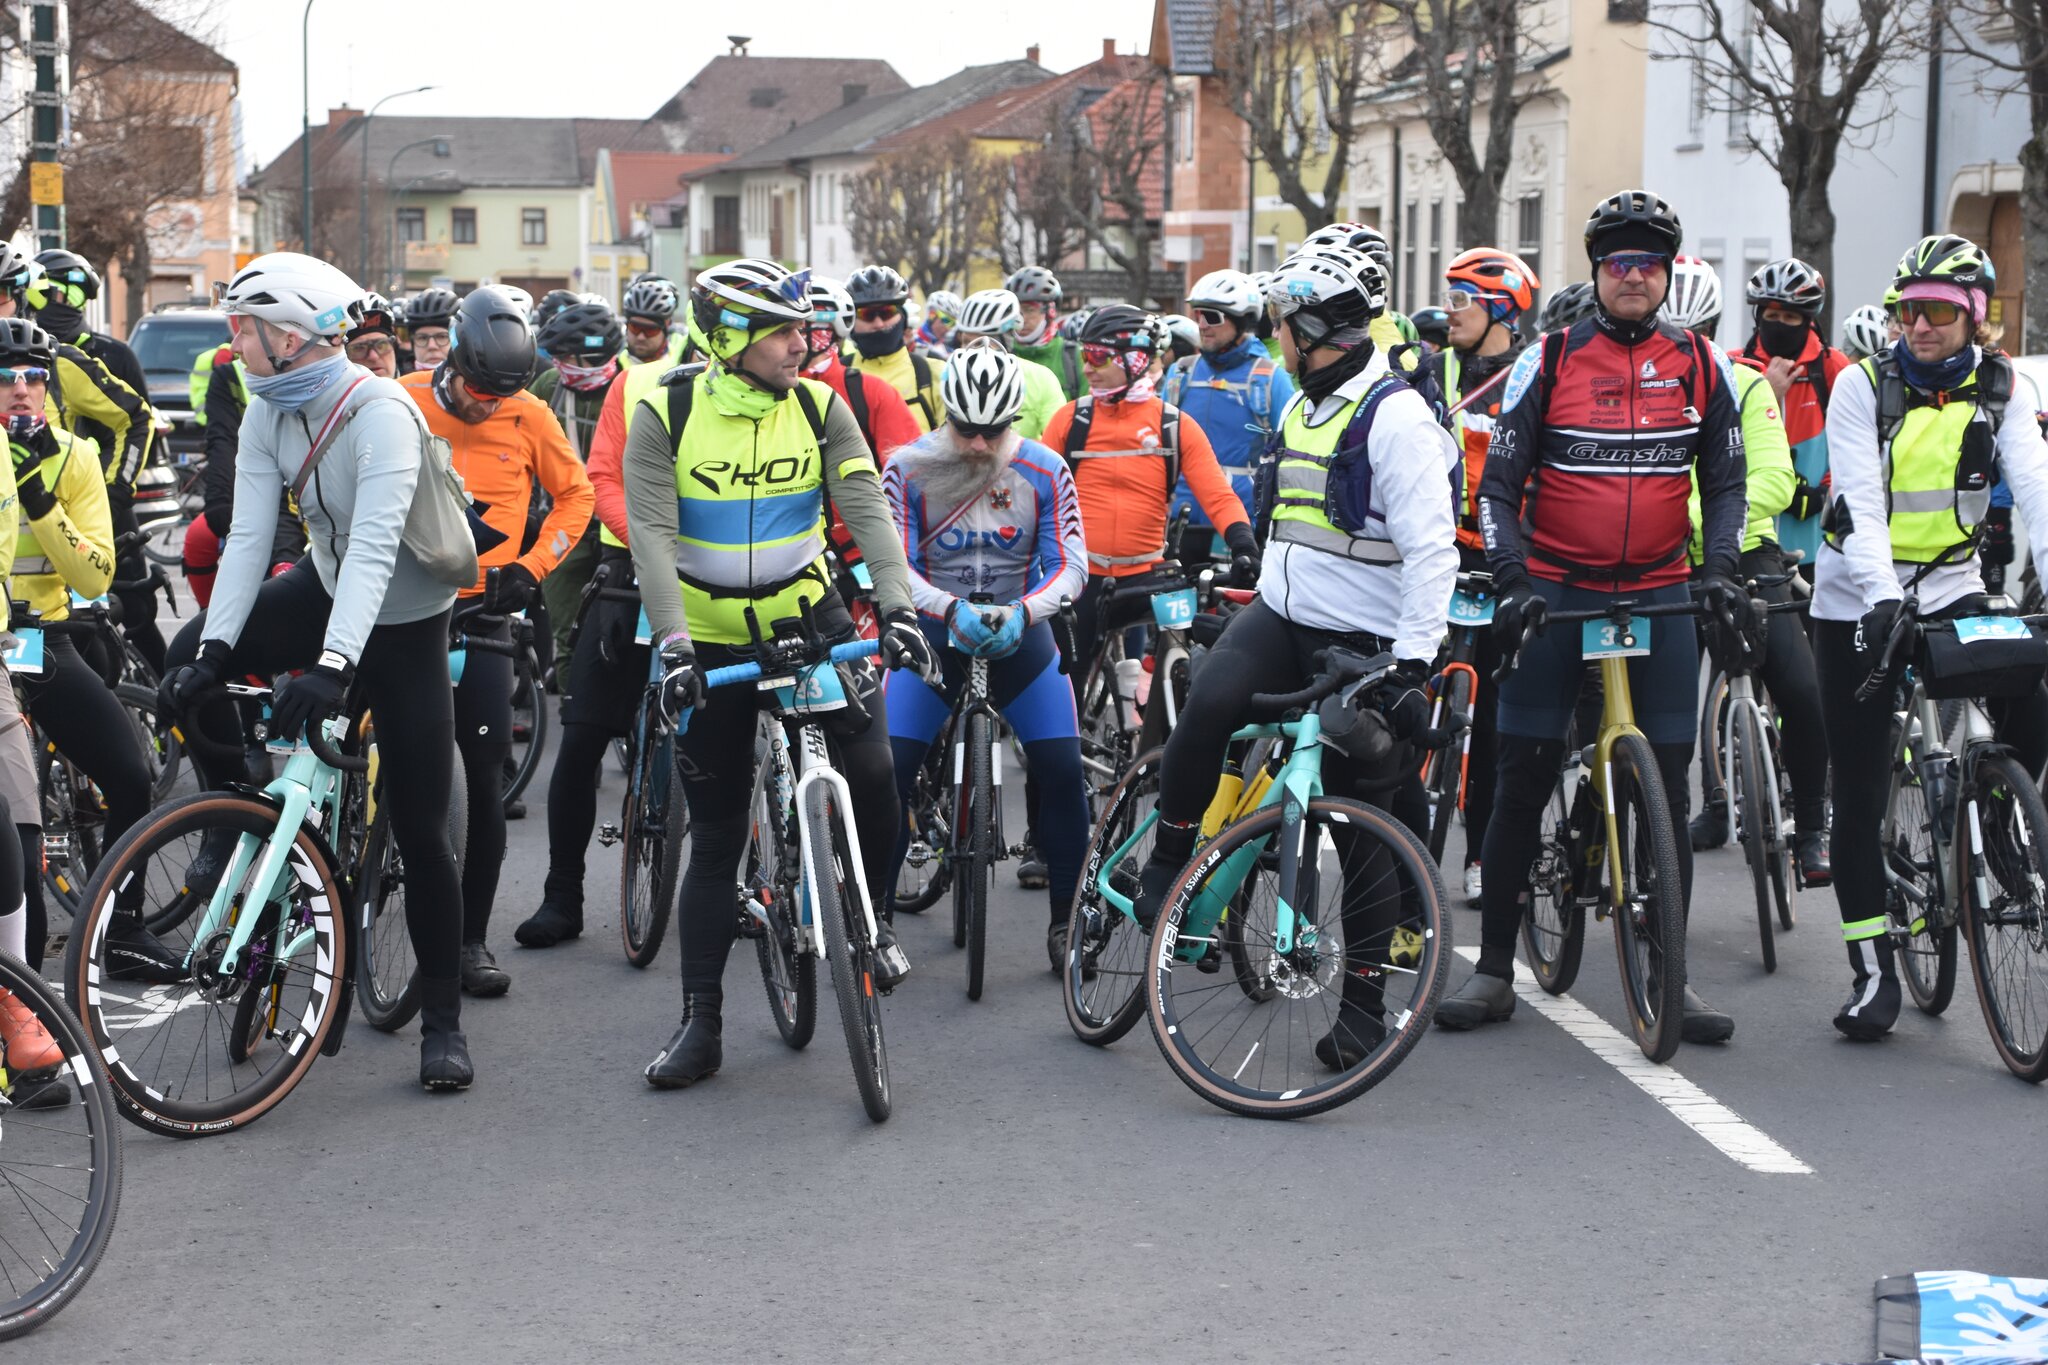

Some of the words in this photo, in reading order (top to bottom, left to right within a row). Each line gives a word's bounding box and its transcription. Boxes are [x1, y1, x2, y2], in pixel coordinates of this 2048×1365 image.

[323, 313, 337, 325] 35
[1640, 381, 1664, 389] SAPIM
[1567, 442, 1687, 463] Gunsha
[765, 482, 816, 495] COMPETITION
[1166, 598, 1190, 620] 75
[1207, 849, 1221, 867] DT
[1185, 863, 1207, 891] SWISS
[200, 1120, 233, 1130] challenge
